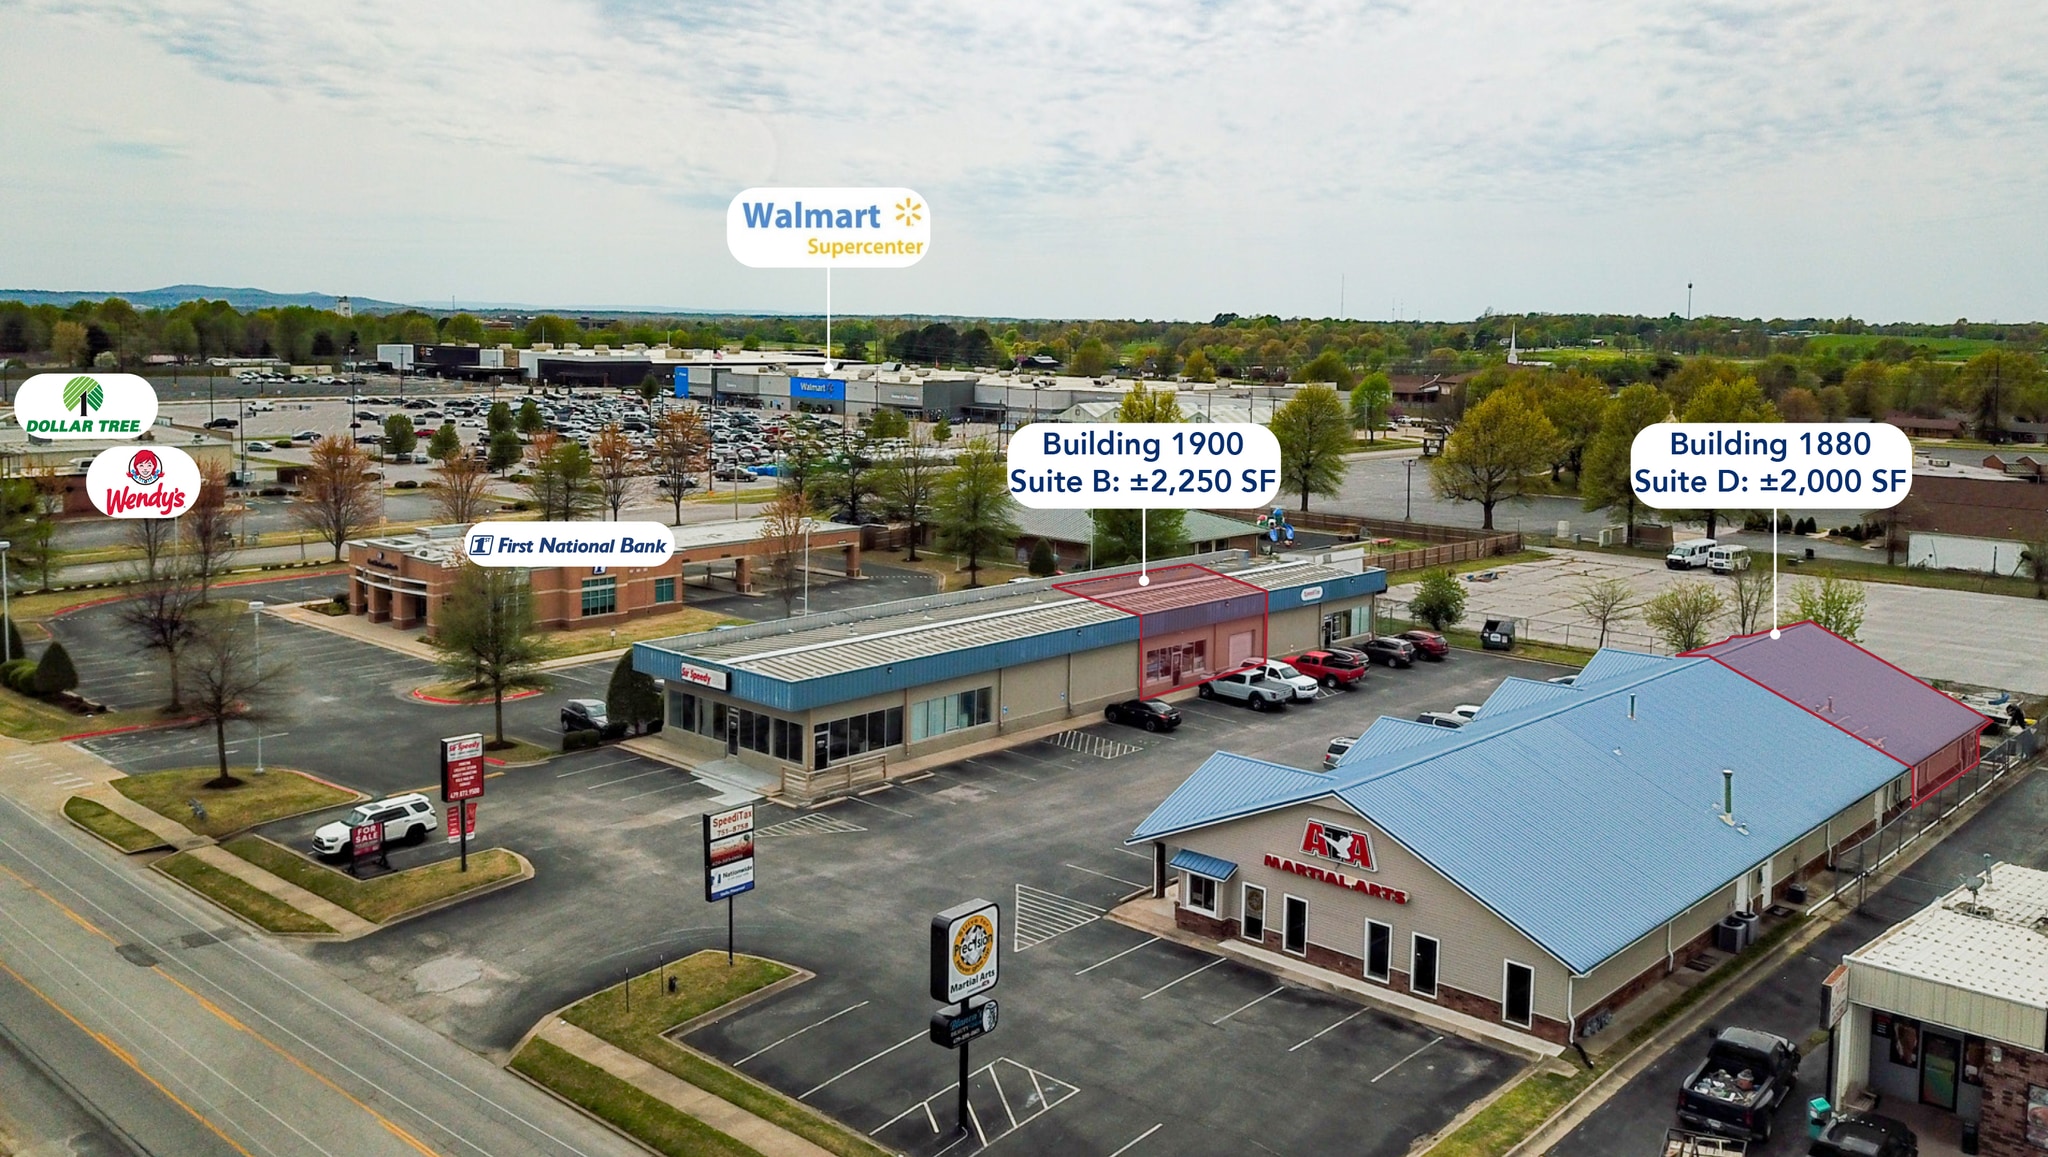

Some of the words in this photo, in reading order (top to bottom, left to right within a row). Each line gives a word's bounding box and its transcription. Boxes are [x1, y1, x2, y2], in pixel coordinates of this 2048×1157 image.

[800, 382, 826, 392] Walmart
[690, 669, 711, 685] Speedy
[457, 741, 480, 752] Speedy
[713, 810, 752, 828] SpeediTax
[355, 831, 378, 843] SALE
[358, 825, 376, 836] FOR
[1301, 820, 1374, 870] ATA
[723, 865, 752, 878] Nationwide
[1264, 854, 1352, 888] MARTIAL
[1353, 879, 1410, 905] ARTS
[950, 975, 978, 994] Martial
[980, 970, 995, 981] Arts
